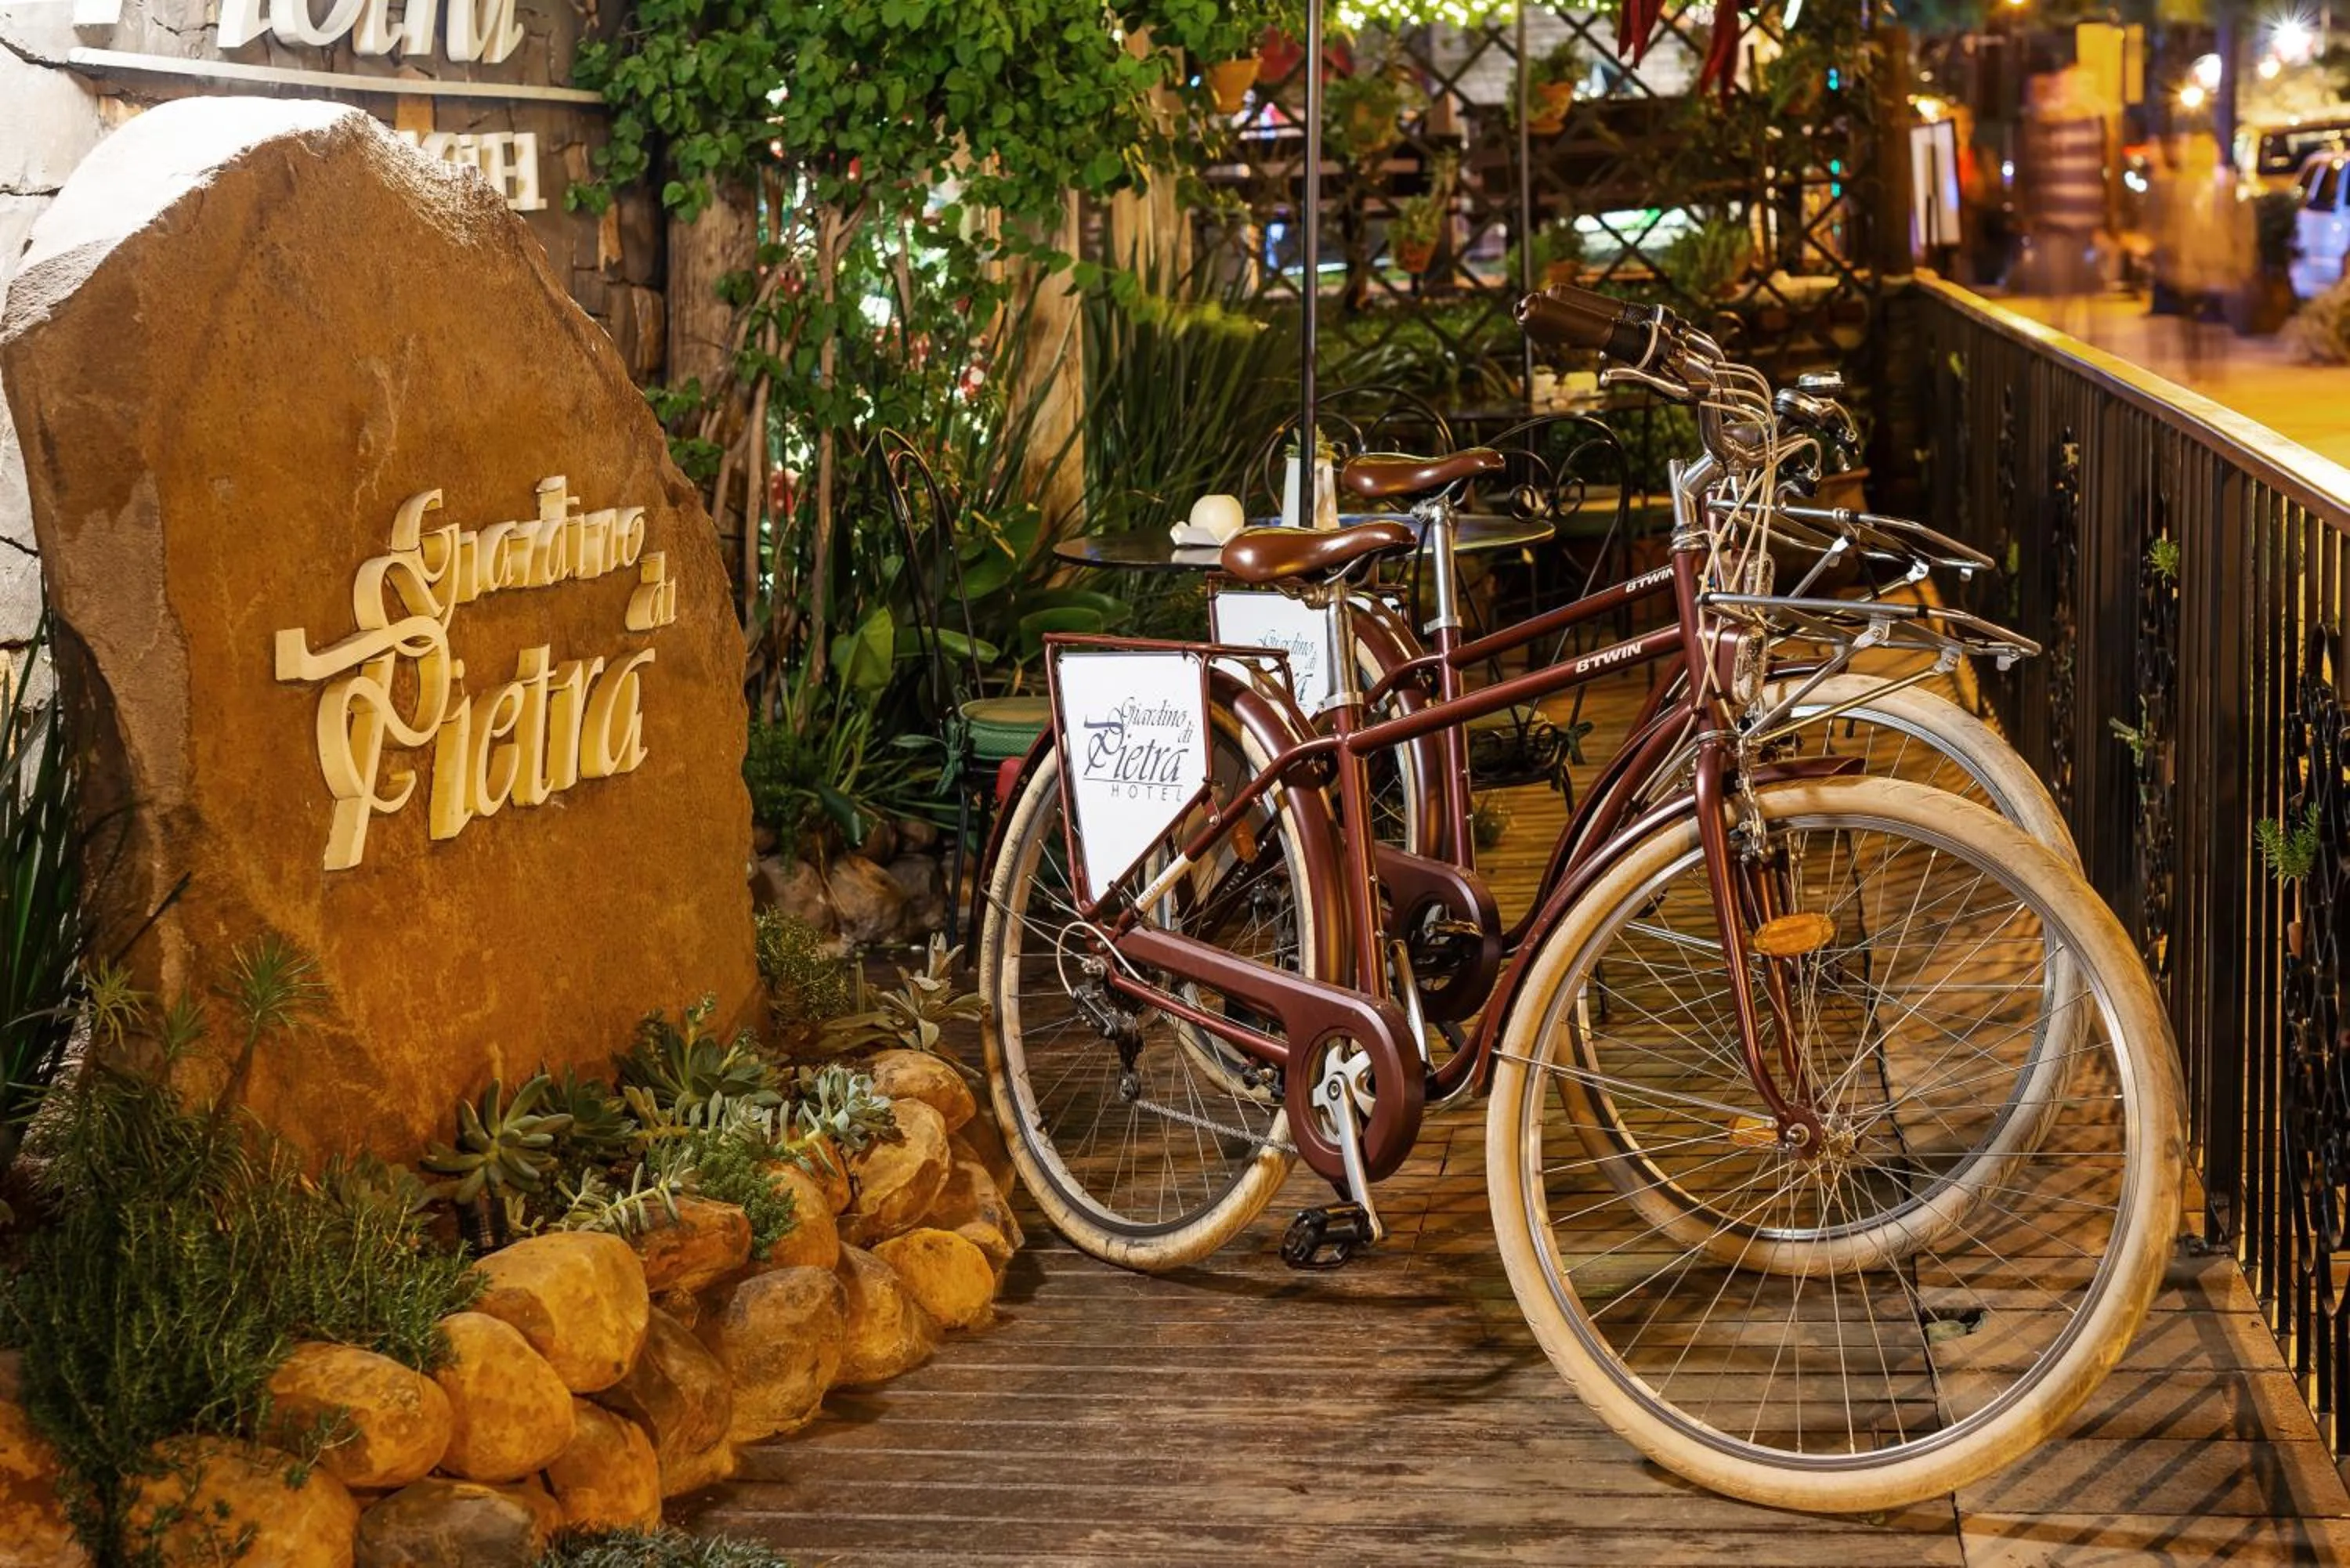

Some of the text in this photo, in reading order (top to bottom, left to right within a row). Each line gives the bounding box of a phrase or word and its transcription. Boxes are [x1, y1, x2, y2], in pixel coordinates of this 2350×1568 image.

[625, 551, 678, 631] di
[1575, 641, 1643, 674] BTWIN
[1108, 695, 1188, 735] Giardino
[275, 615, 656, 871] Pietra
[1083, 714, 1190, 783] Pietra
[1110, 784, 1182, 803] HOTEL
